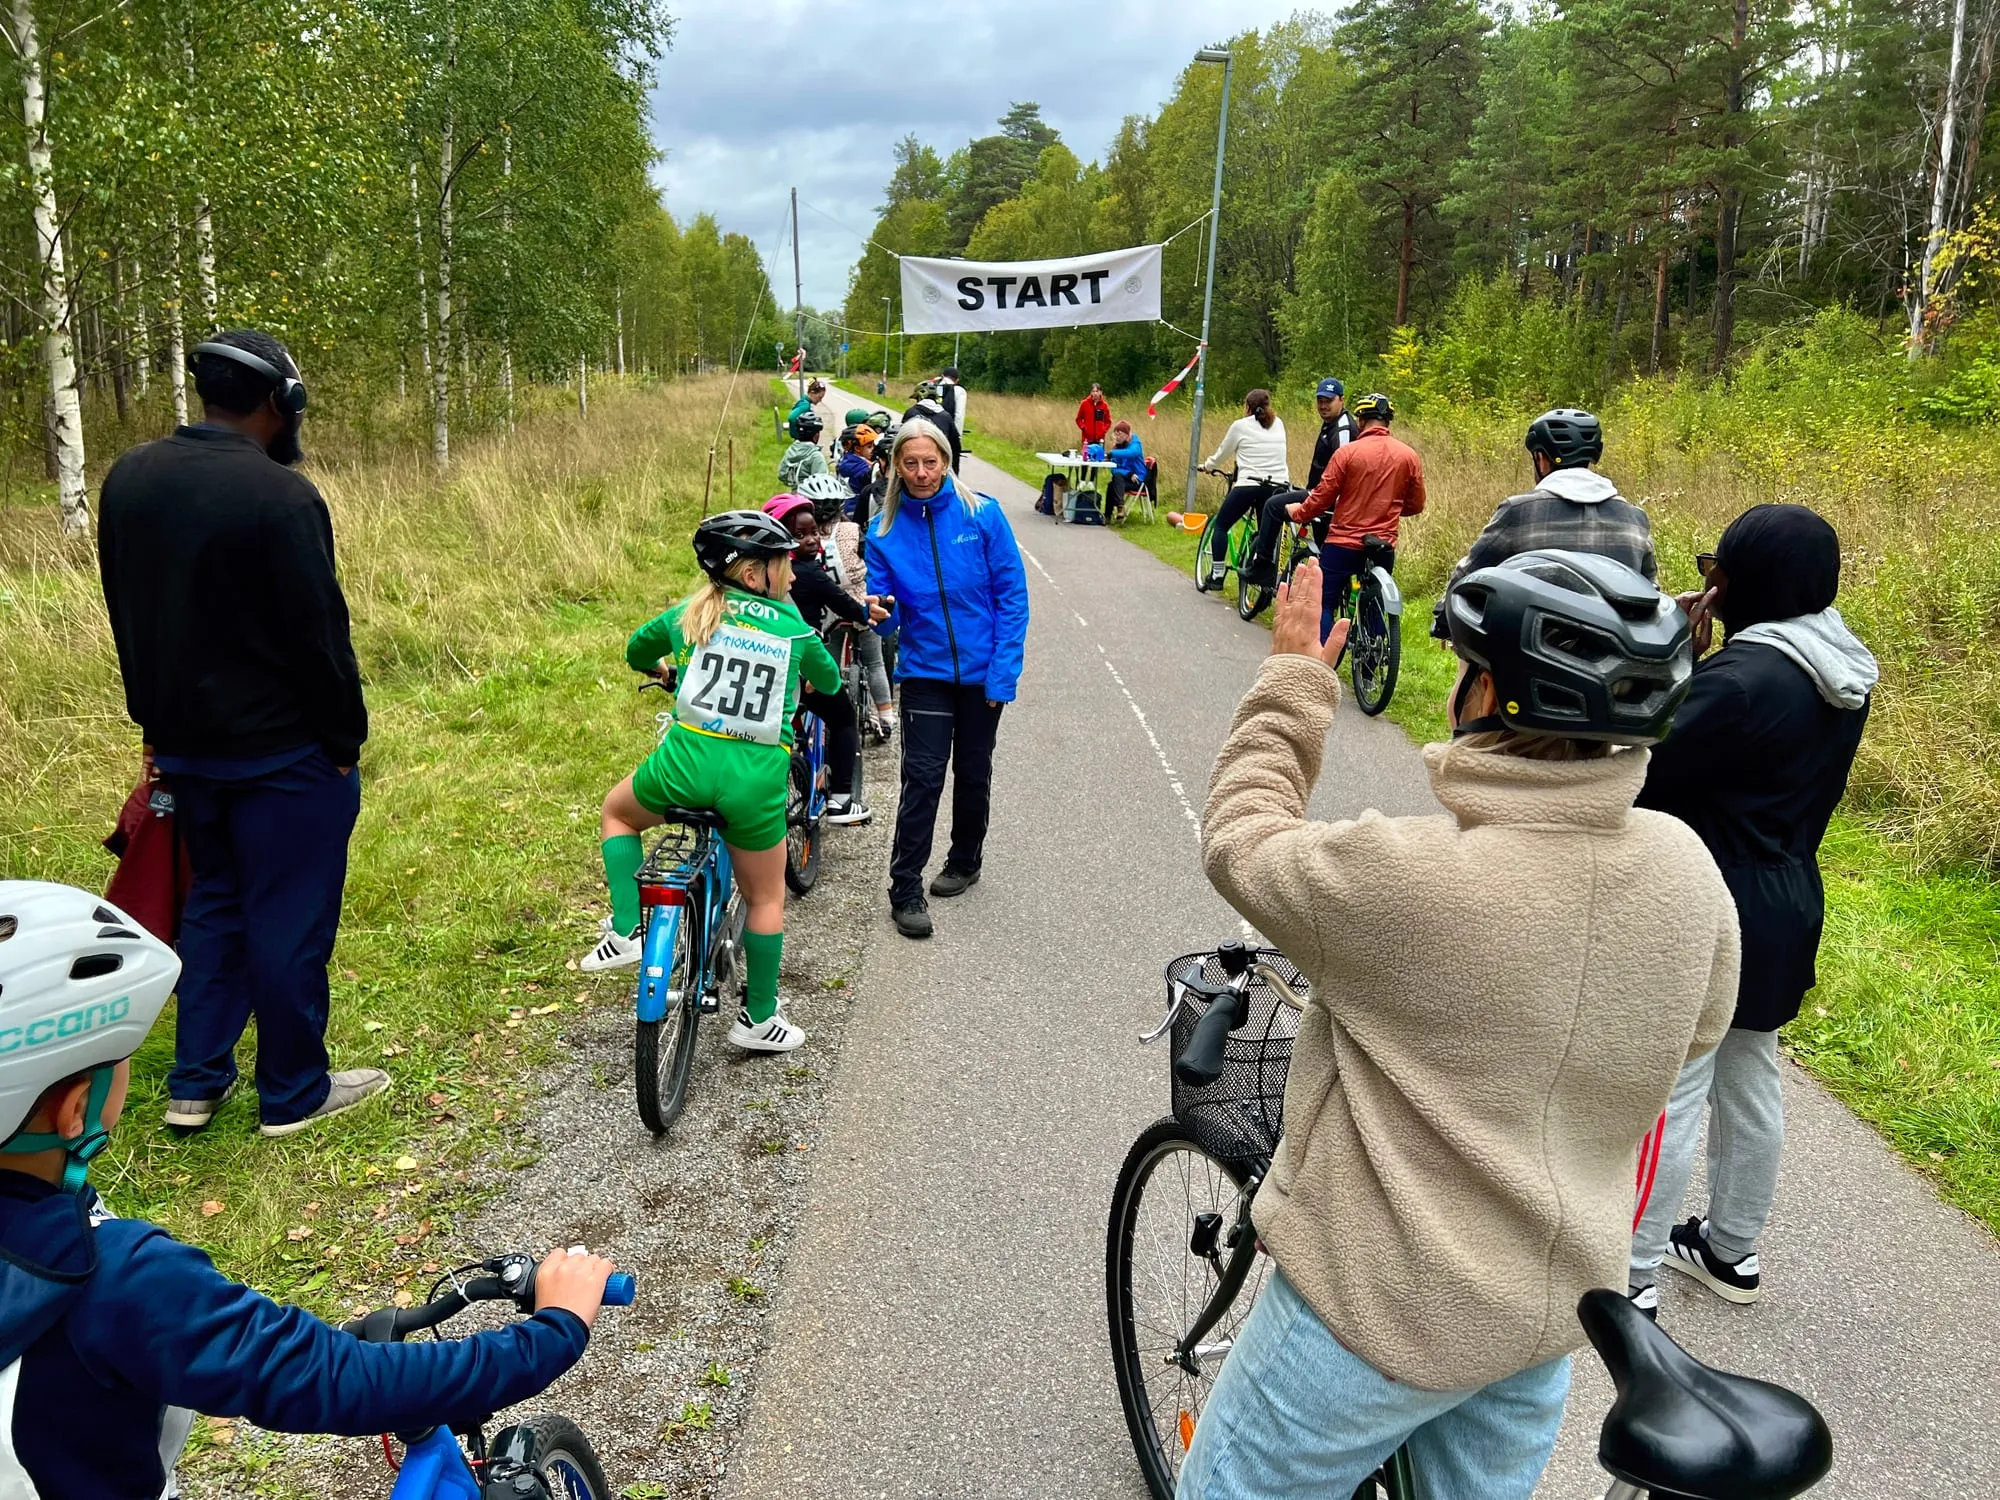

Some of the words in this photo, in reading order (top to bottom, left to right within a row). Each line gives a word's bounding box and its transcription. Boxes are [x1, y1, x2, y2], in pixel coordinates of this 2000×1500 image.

[957, 270, 1109, 311] START
[726, 599, 779, 621] cron
[690, 652, 777, 723] 233
[0, 996, 130, 1054] ccano
